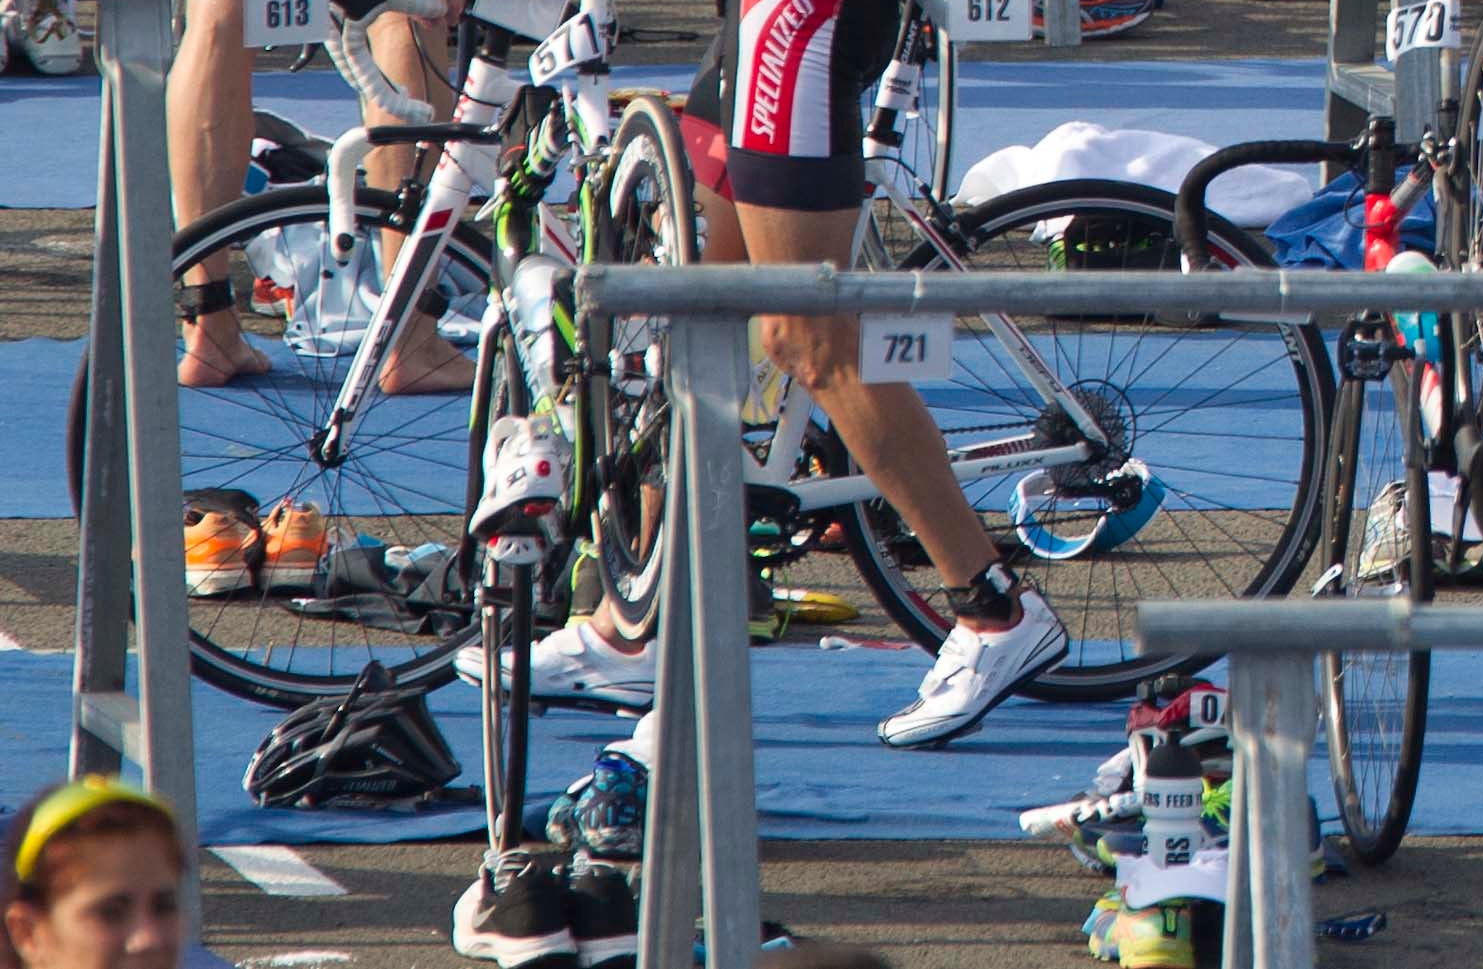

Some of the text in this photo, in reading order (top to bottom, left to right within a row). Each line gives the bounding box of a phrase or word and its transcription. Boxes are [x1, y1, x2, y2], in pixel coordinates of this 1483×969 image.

[535, 12, 601, 75] 571
[1392, 1, 1445, 49] 570
[881, 334, 926, 363] 721
[1165, 791, 1194, 808] FEED
